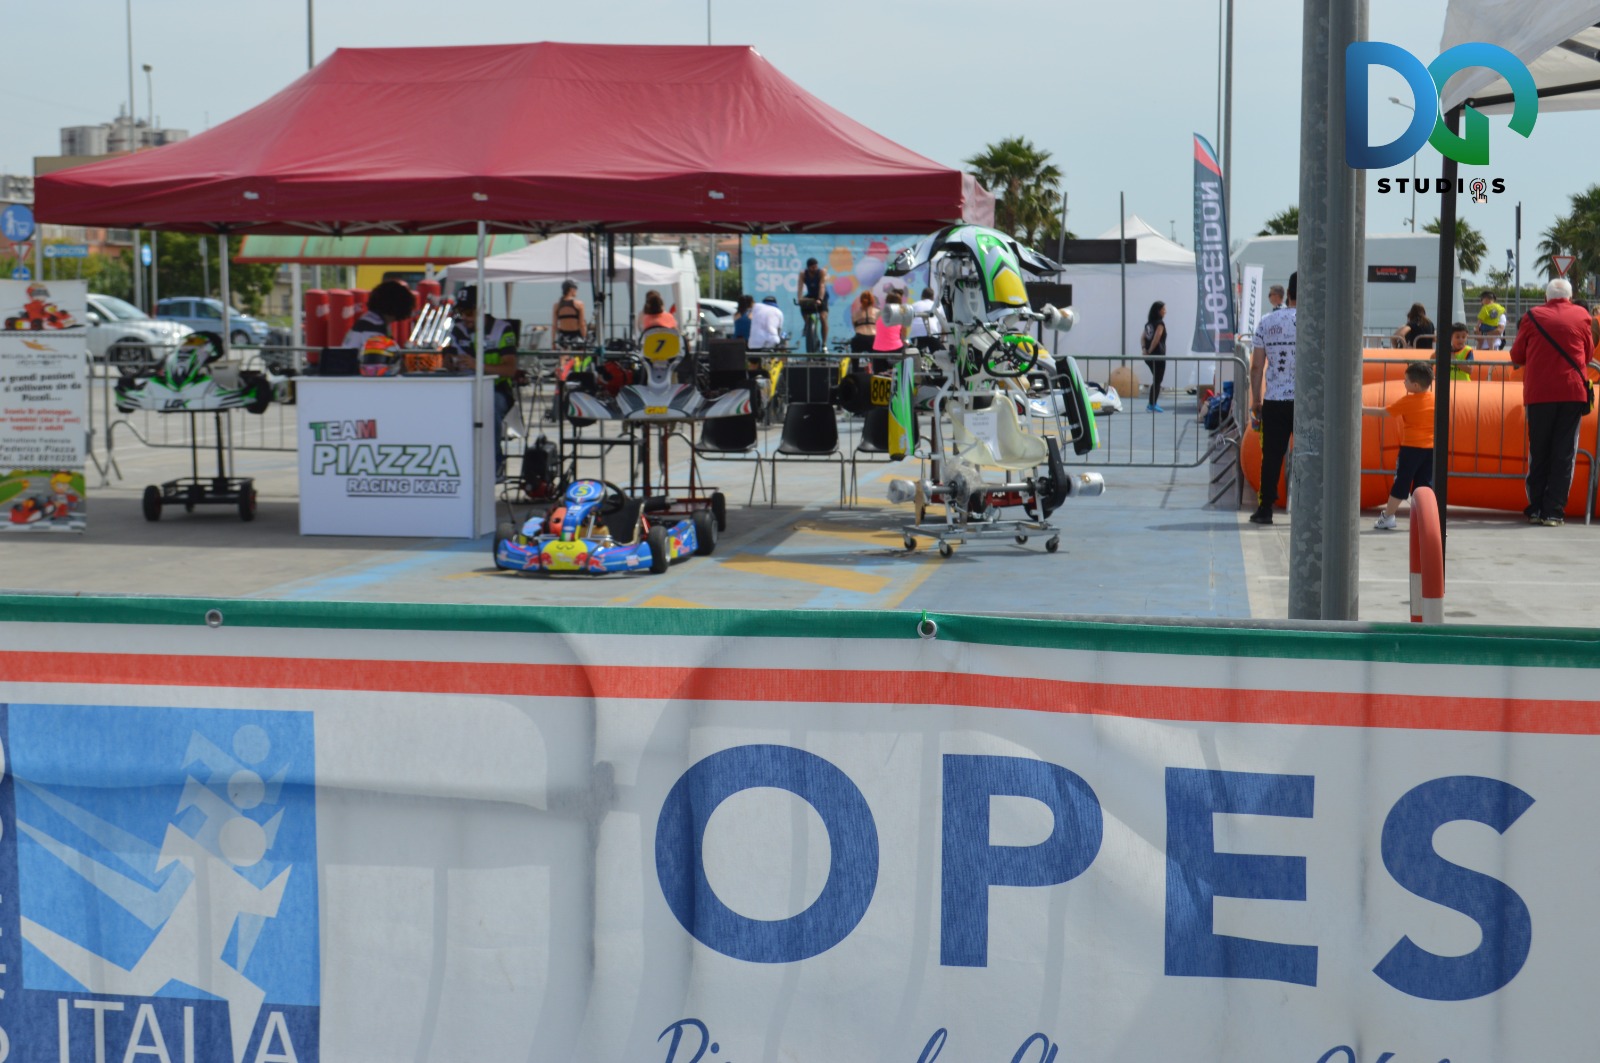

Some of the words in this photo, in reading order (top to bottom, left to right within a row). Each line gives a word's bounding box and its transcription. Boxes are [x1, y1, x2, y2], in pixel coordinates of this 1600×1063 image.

[754, 243, 797, 257] FESTA
[755, 257, 802, 271] DELLO
[755, 272, 807, 292] SPO
[654, 339, 667, 353] 7
[309, 419, 377, 441] TEAM
[312, 443, 460, 477] PIAZZA
[347, 478, 411, 493] RACING
[413, 479, 461, 494] KART
[655, 743, 1536, 1000] OPES
